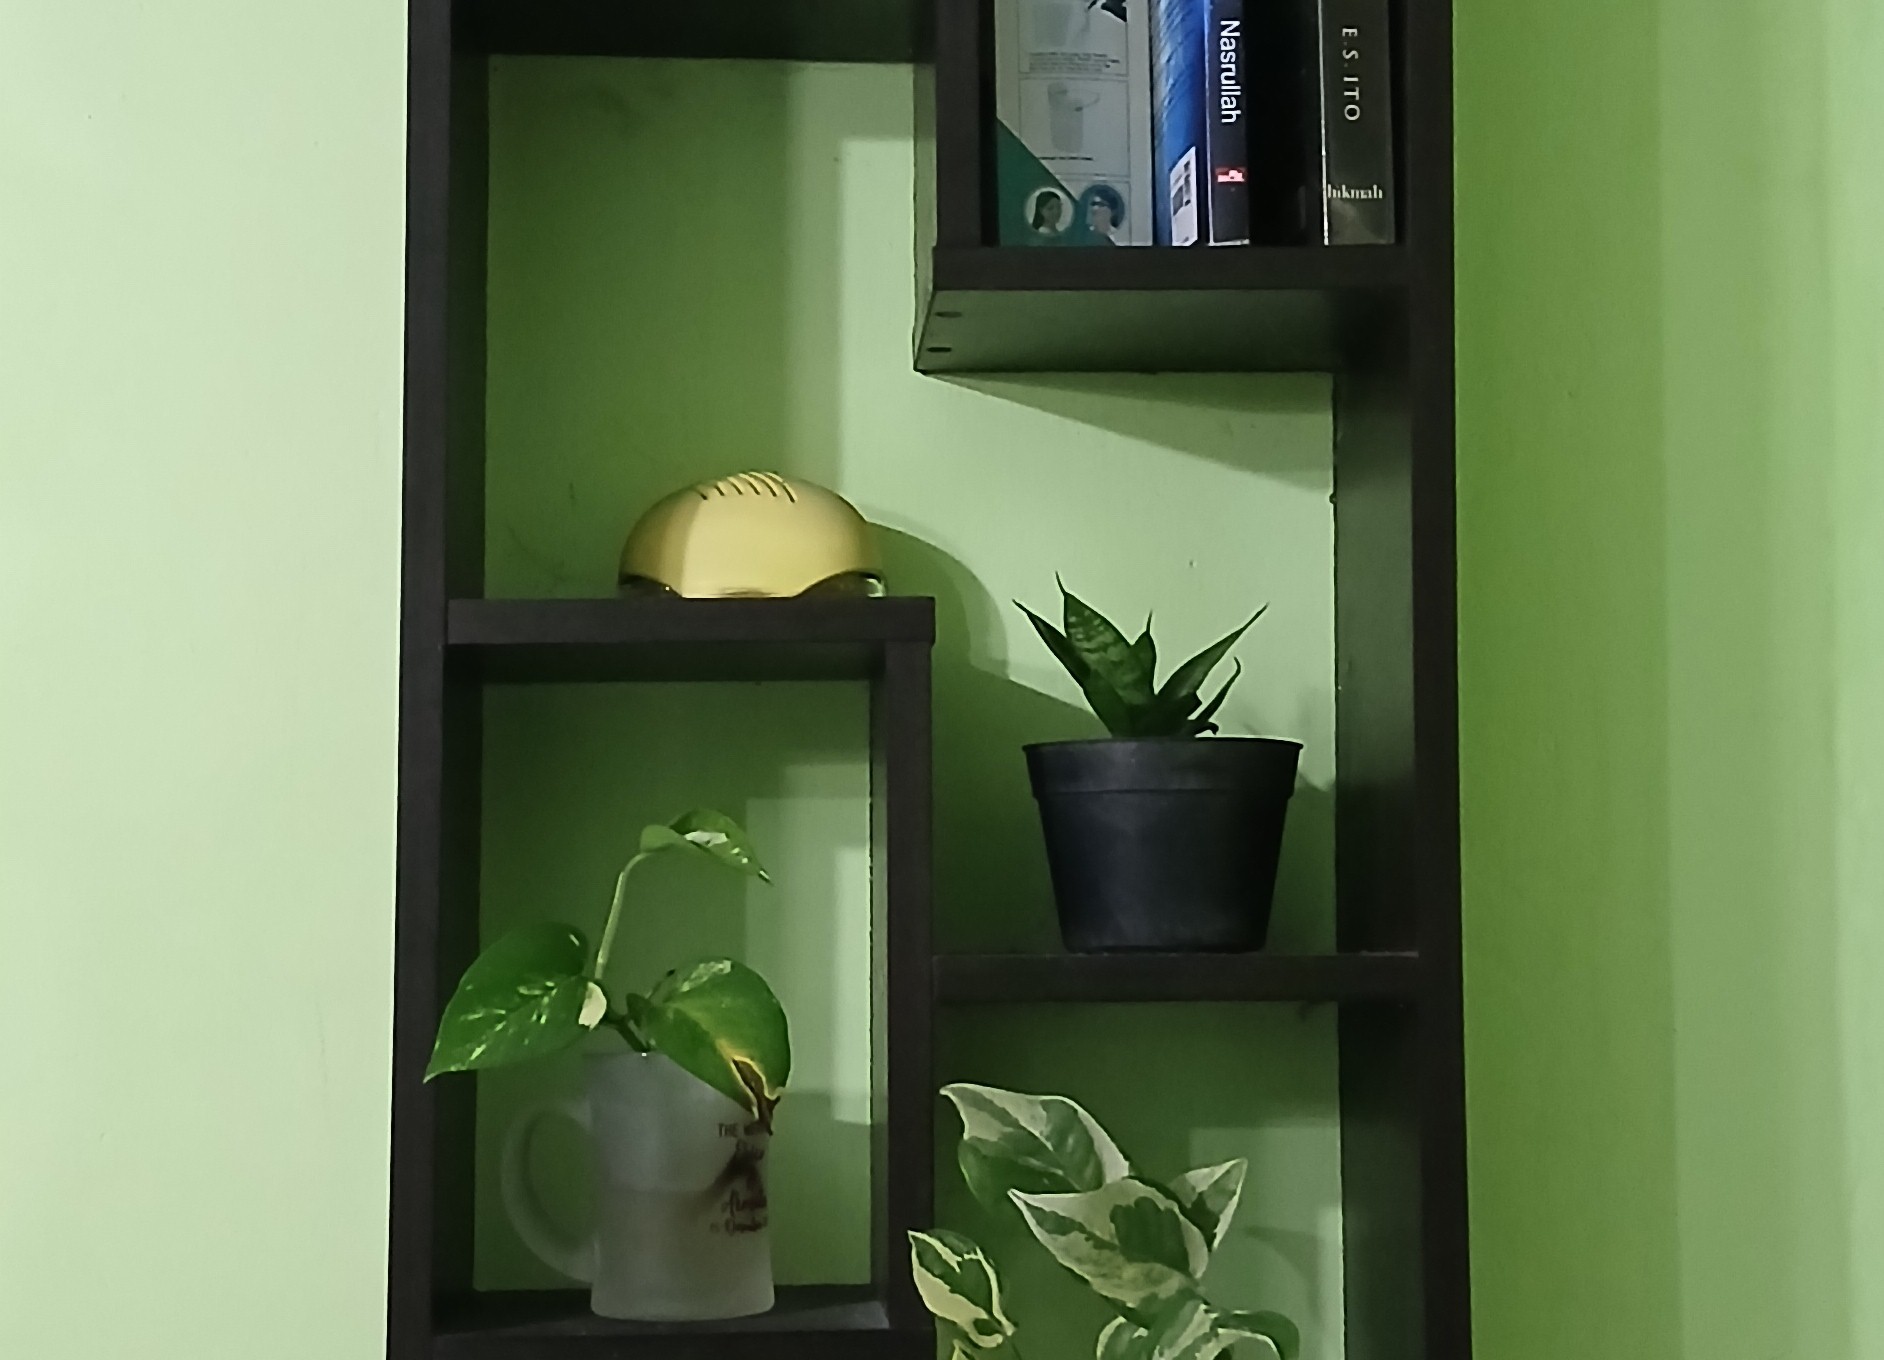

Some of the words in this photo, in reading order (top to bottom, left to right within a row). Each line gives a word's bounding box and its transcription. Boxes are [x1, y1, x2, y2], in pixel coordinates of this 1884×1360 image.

[1220, 20, 1242, 124] Nasrullah
[1343, 77, 1361, 121] ITO
[1328, 184, 1383, 199] hikmah
